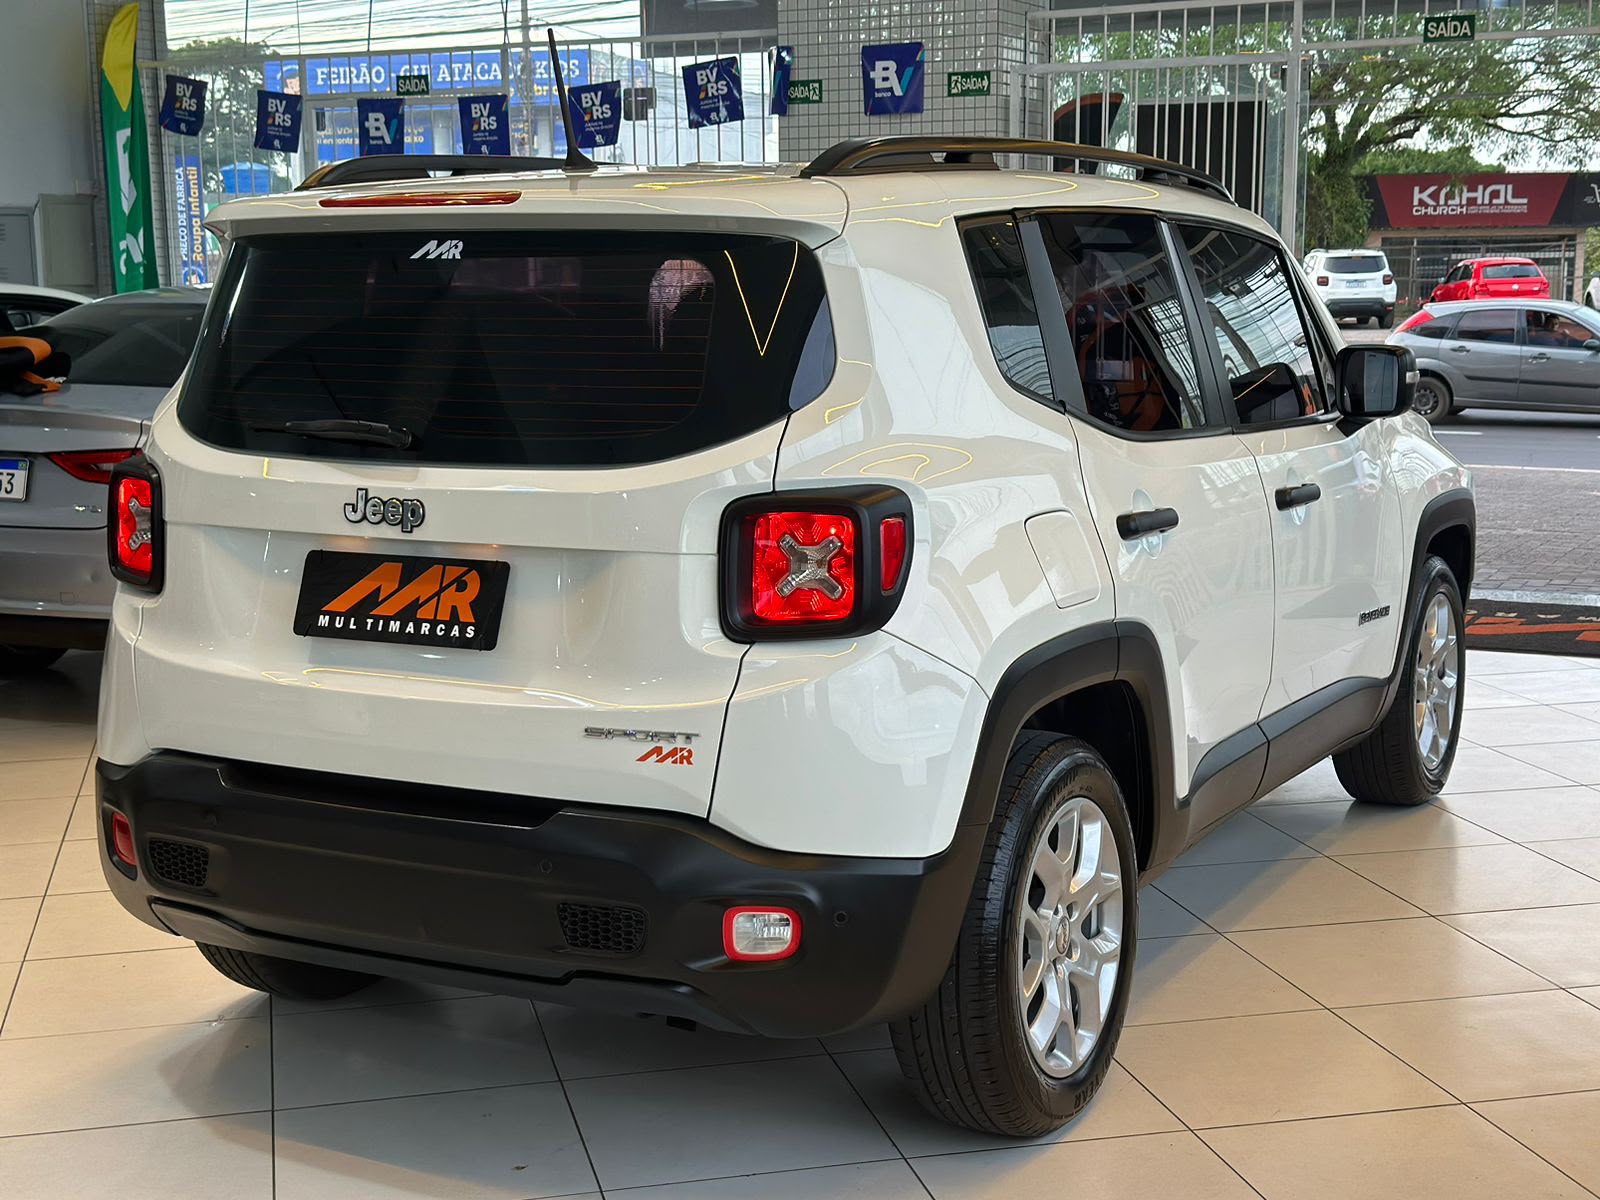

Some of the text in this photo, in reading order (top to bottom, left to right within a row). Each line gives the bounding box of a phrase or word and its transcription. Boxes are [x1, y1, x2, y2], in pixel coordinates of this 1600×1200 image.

[1427, 18, 1471, 37] SAÍDA
[316, 63, 385, 85] FEIRÃO
[696, 67, 718, 86] BV
[398, 78, 428, 92] SAÍDA
[706, 81, 728, 97] RS
[961, 75, 983, 90] SAÍDA
[176, 83, 193, 98] BV
[789, 84, 810, 98] SAÍDA
[182, 97, 198, 111] RS
[267, 98, 286, 113] BV
[581, 91, 602, 108] BV
[471, 103, 491, 118] BV
[592, 105, 612, 120] RS
[274, 113, 292, 127] RS
[480, 117, 497, 130] RS
[1412, 205, 1466, 216] CHURCH
[344, 488, 426, 533] Jeep
[318, 614, 475, 638] MULTIMARCAS
[584, 726, 700, 744] SPORT
